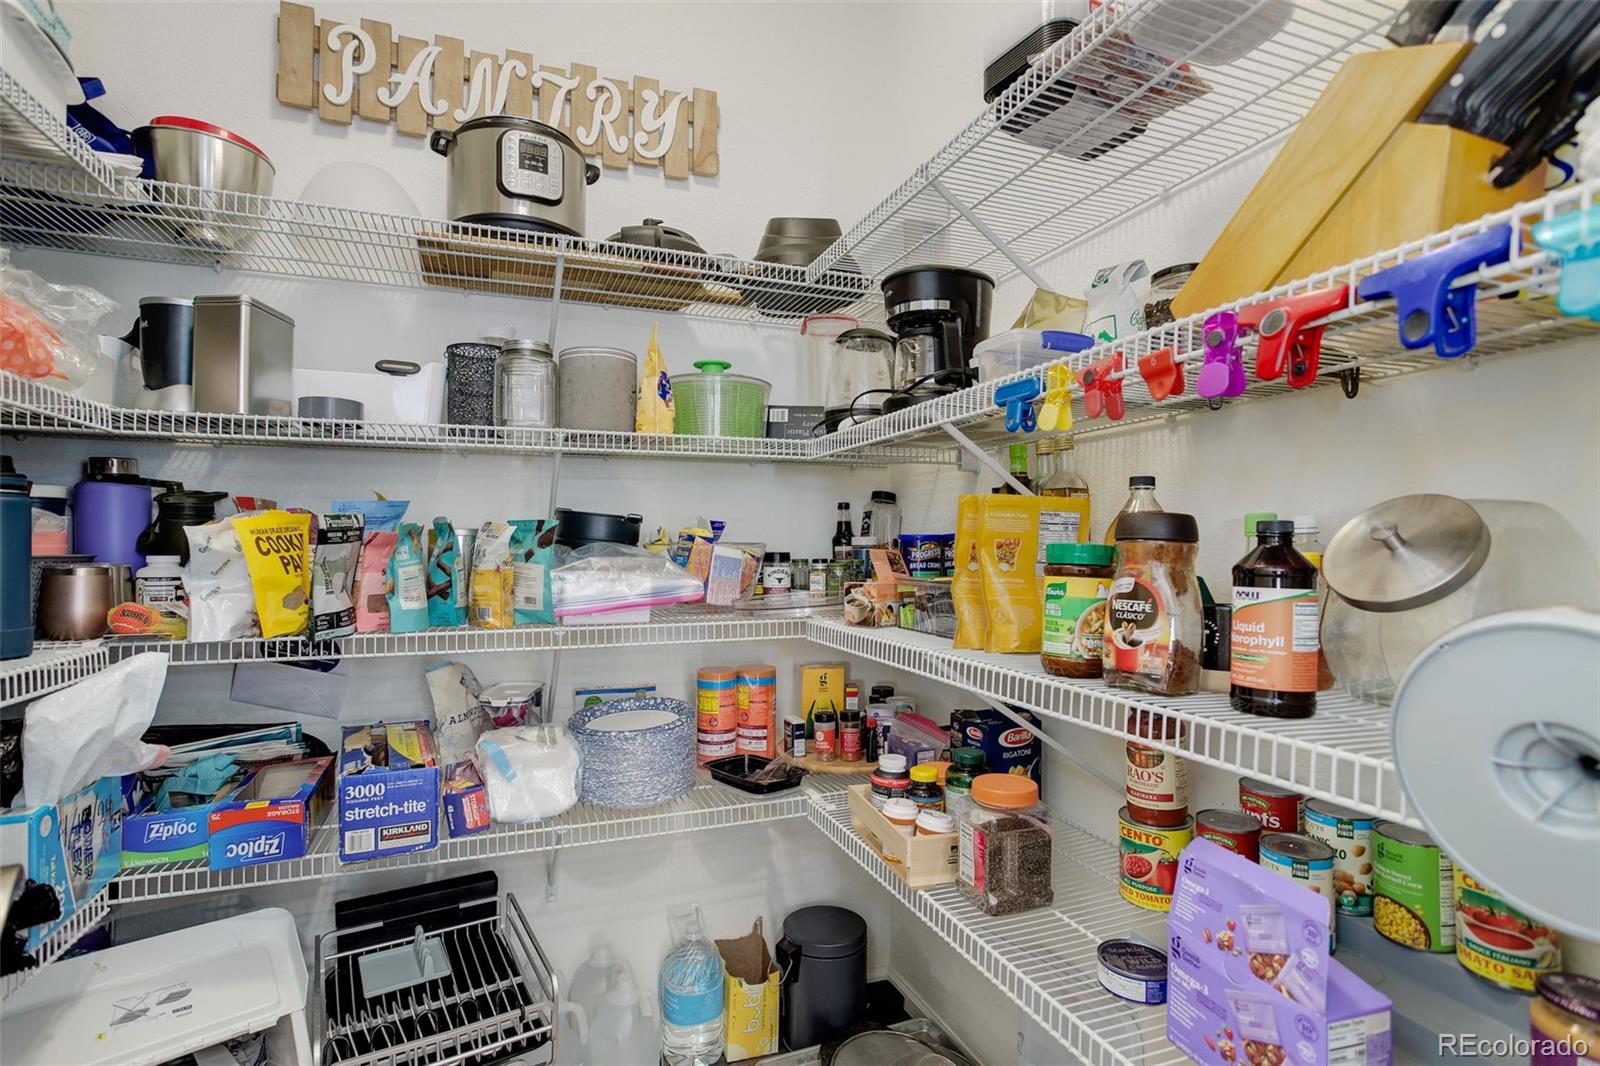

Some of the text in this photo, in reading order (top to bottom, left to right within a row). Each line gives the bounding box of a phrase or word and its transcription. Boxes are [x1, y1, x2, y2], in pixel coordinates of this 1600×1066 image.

[323, 24, 690, 158] PANTRY
[1112, 598, 1152, 613] NESCAFÉ
[1115, 610, 1144, 621] CLÁSICO
[1232, 620, 1265, 634] Liquid
[1007, 730, 1032, 743] Barilla
[1002, 748, 1032, 760] RIGATONI
[1127, 765, 1164, 784] RAO'S
[345, 782, 386, 800] 3000
[344, 799, 427, 821] stretch-tite
[1248, 797, 1268, 809] NATURAL
[211, 813, 222, 821] 75
[266, 808, 300, 817] STORAGE
[149, 820, 198, 841] Ziploc
[382, 823, 428, 836] KIRKLAND
[1120, 826, 1163, 846] CENTO
[1337, 830, 1353, 838] FIBER
[226, 834, 280, 858] Ziploc
[1212, 835, 1234, 847] NATURAL
[71, 823, 83, 877] FLEX
[124, 857, 169, 868] SANDWICH
[1292, 870, 1309, 879] FIBER
[1131, 880, 1158, 893] PURPOSE
[1181, 876, 1210, 896] Omega-3
[1403, 880, 1423, 889] Corn
[1136, 891, 1174, 905] TOMATO
[1491, 950, 1532, 966] ITALIANO
[1170, 962, 1209, 995] Omega-3
